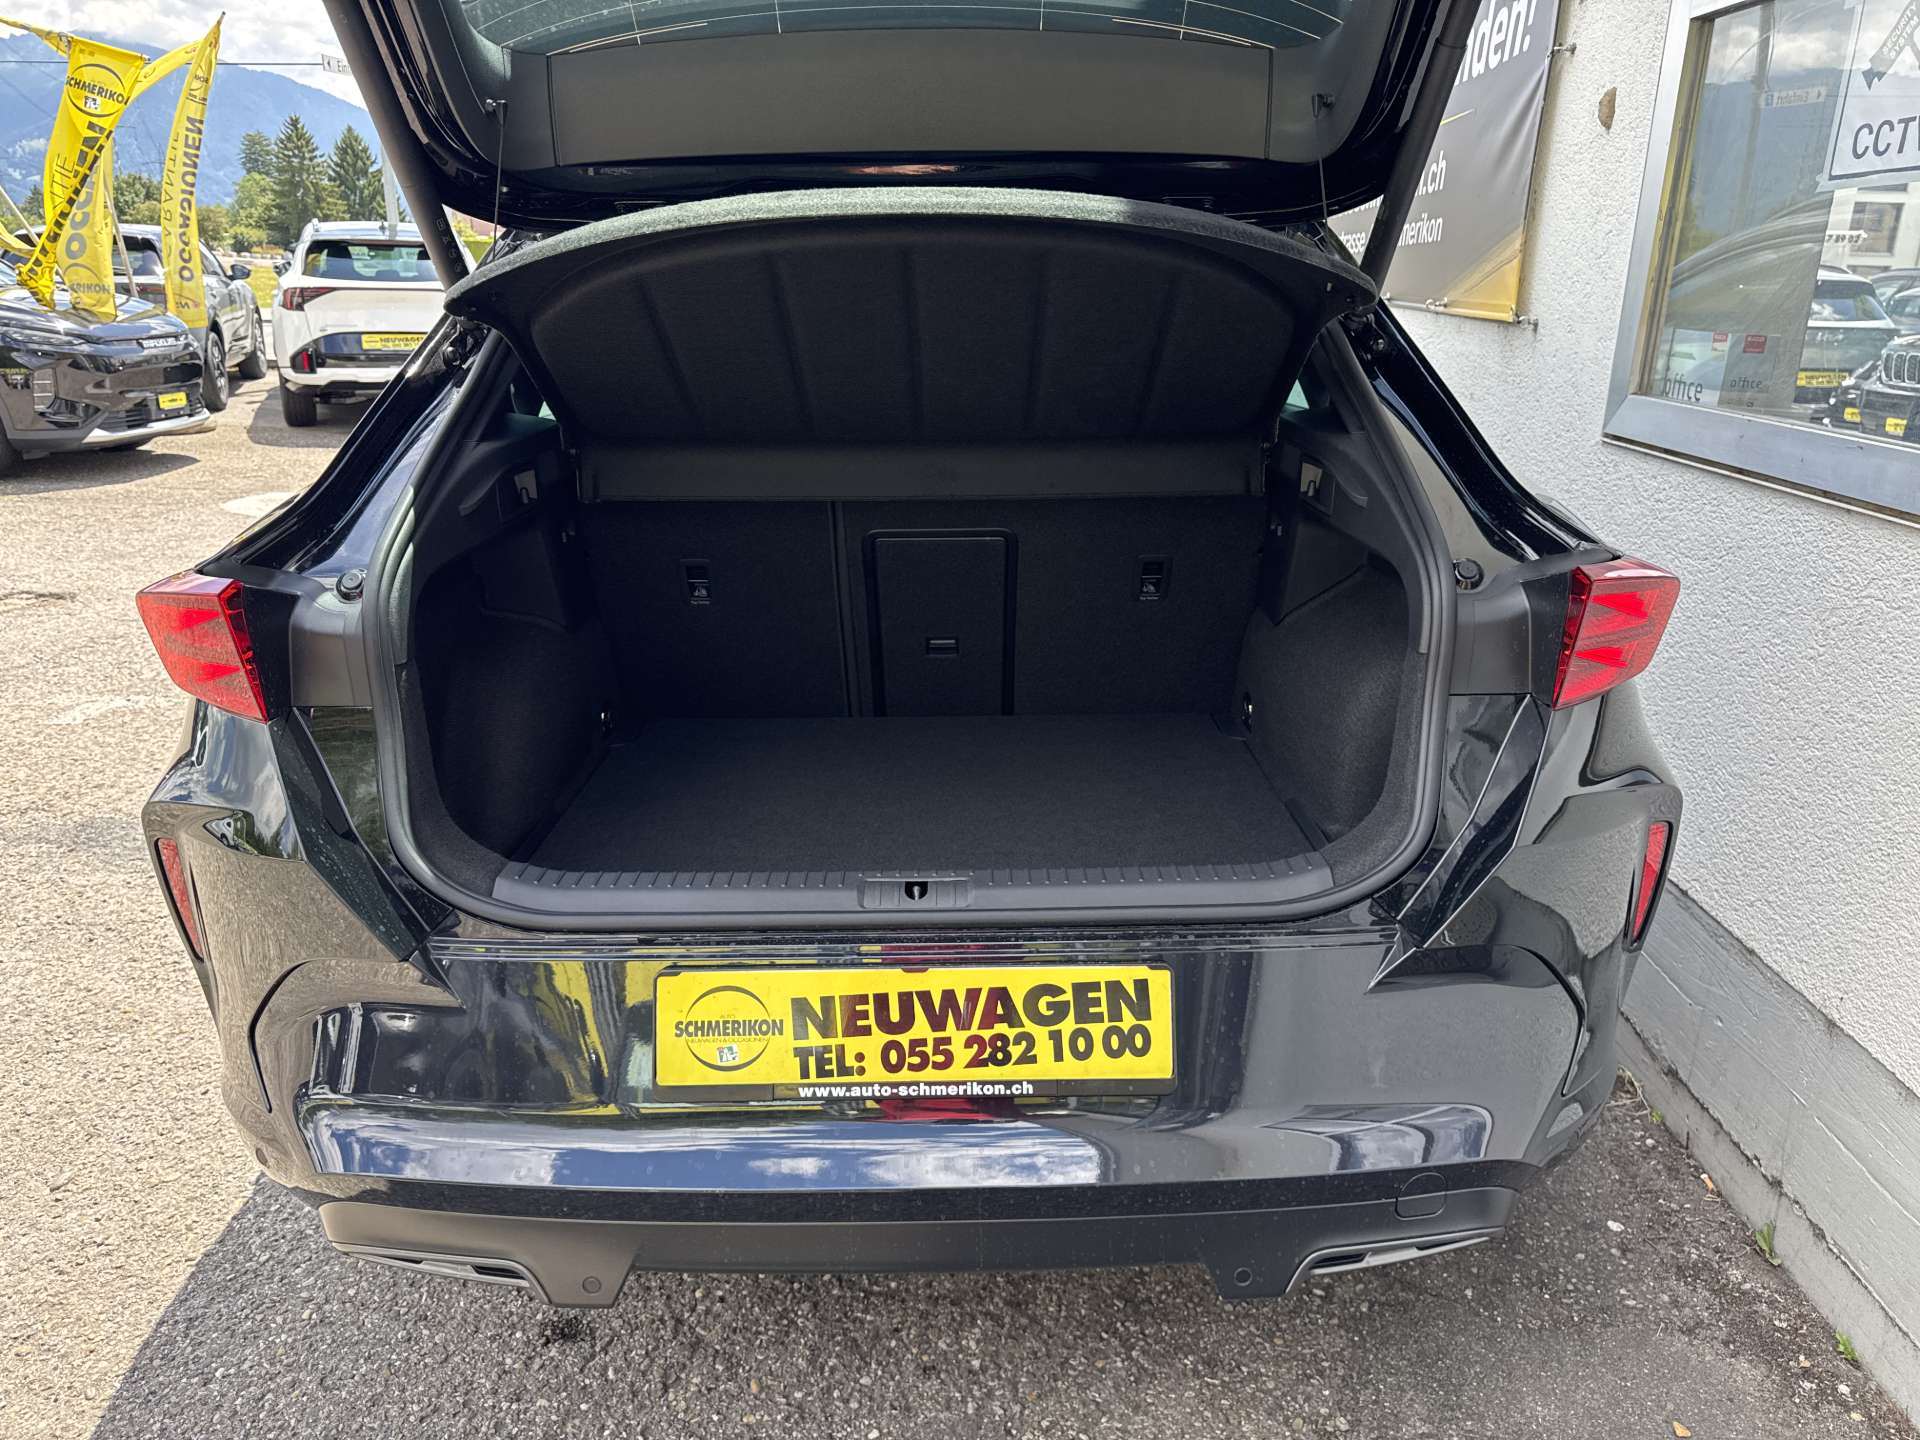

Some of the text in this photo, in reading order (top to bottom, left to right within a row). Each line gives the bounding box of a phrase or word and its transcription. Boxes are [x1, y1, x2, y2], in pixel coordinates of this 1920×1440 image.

[1852, 115, 1920, 160] CCT
[674, 1019, 784, 1037] SCHMERIKON
[791, 979, 1152, 1041] NEUWAGEN
[793, 1023, 1152, 1080] TEL: 055 282 10 00
[798, 1081, 1034, 1097] www.auto-schmerikon.ch
